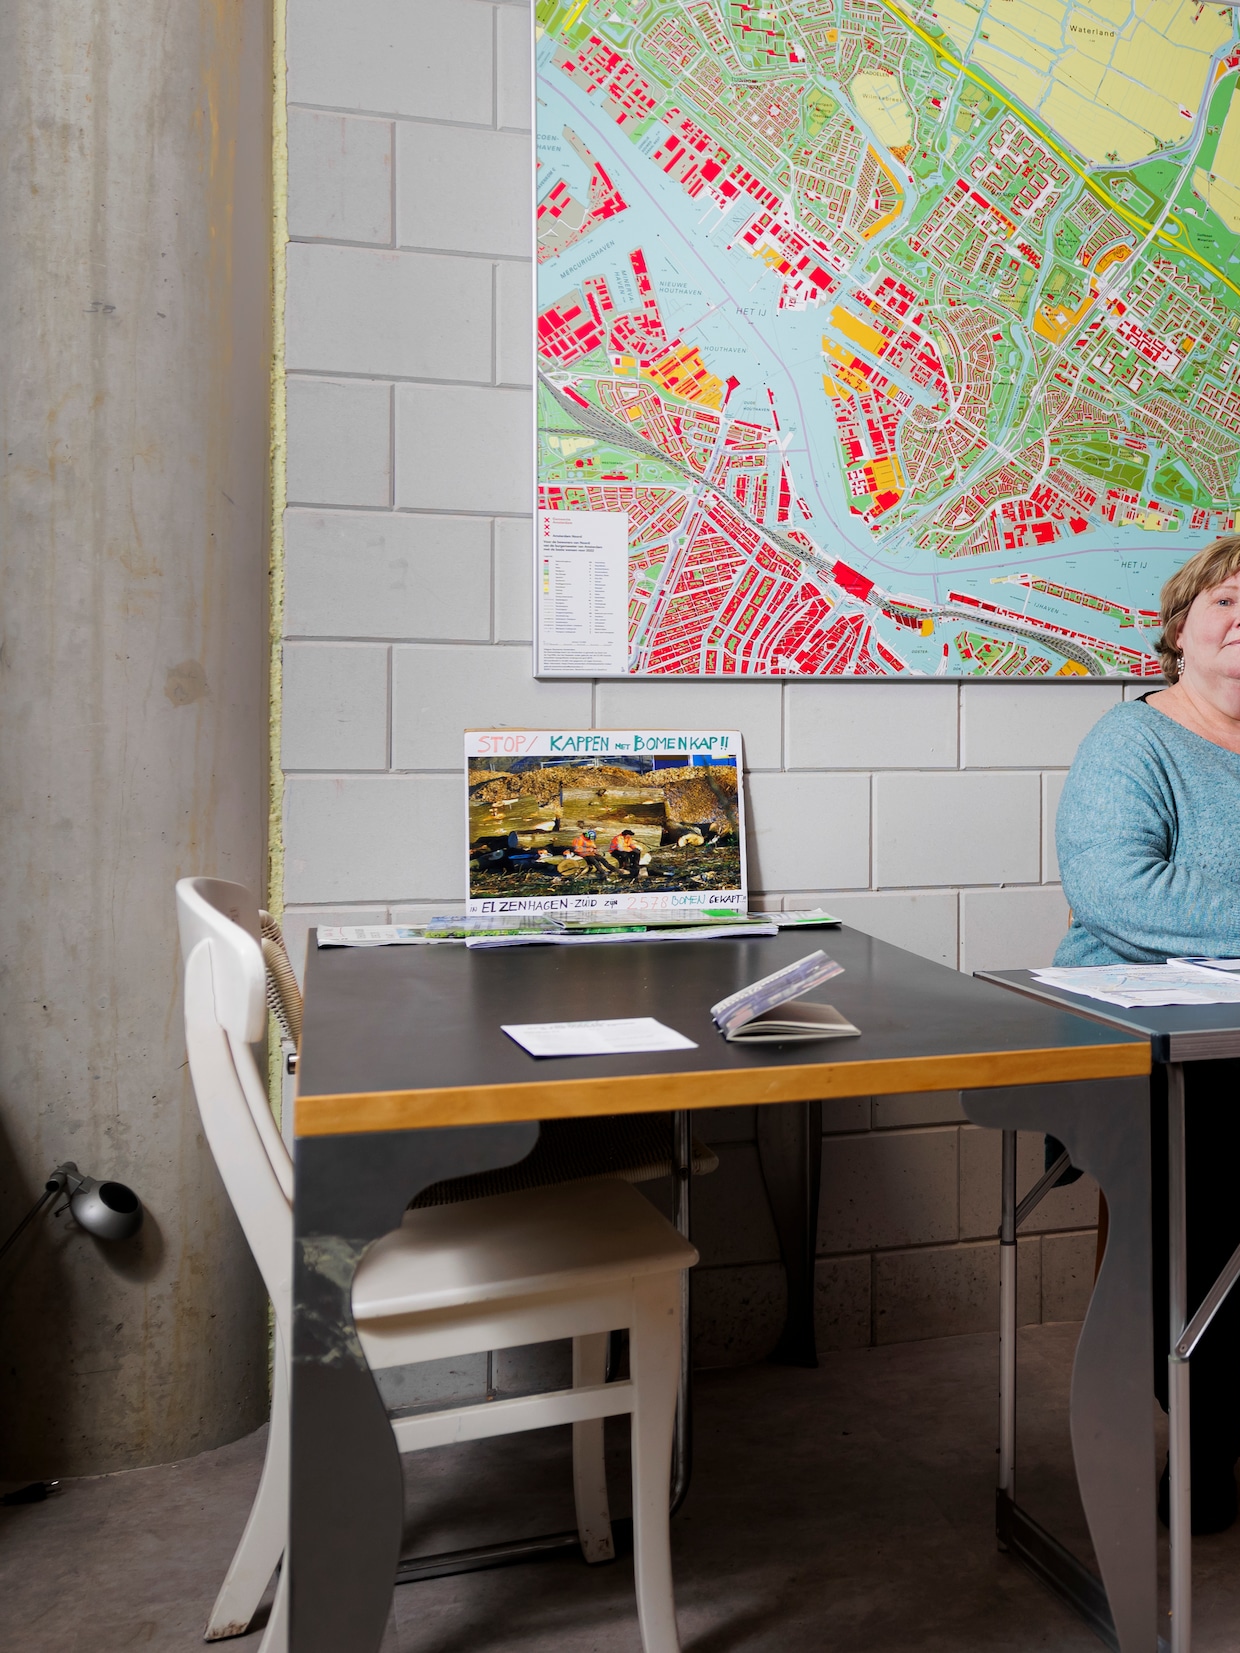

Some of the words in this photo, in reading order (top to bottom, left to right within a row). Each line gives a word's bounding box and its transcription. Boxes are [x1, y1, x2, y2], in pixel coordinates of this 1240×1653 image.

[1069, 24, 1115, 38] Waterland
[559, 240, 616, 279] MERCURIUSHAVEN
[659, 281, 687, 289] NIEUWE
[659, 287, 702, 296] HOUTHAVEN
[736, 307, 755, 316] HET
[758, 308, 767, 317] IJ
[704, 346, 747, 354] HOUTHAVEN
[1121, 561, 1138, 569] HET
[1140, 561, 1148, 569] IJ
[1033, 602, 1060, 614] IJHAVEN
[550, 735, 609, 752] KAPPEN
[626, 895, 669, 911] 2578
[671, 894, 706, 906] BOMEN
